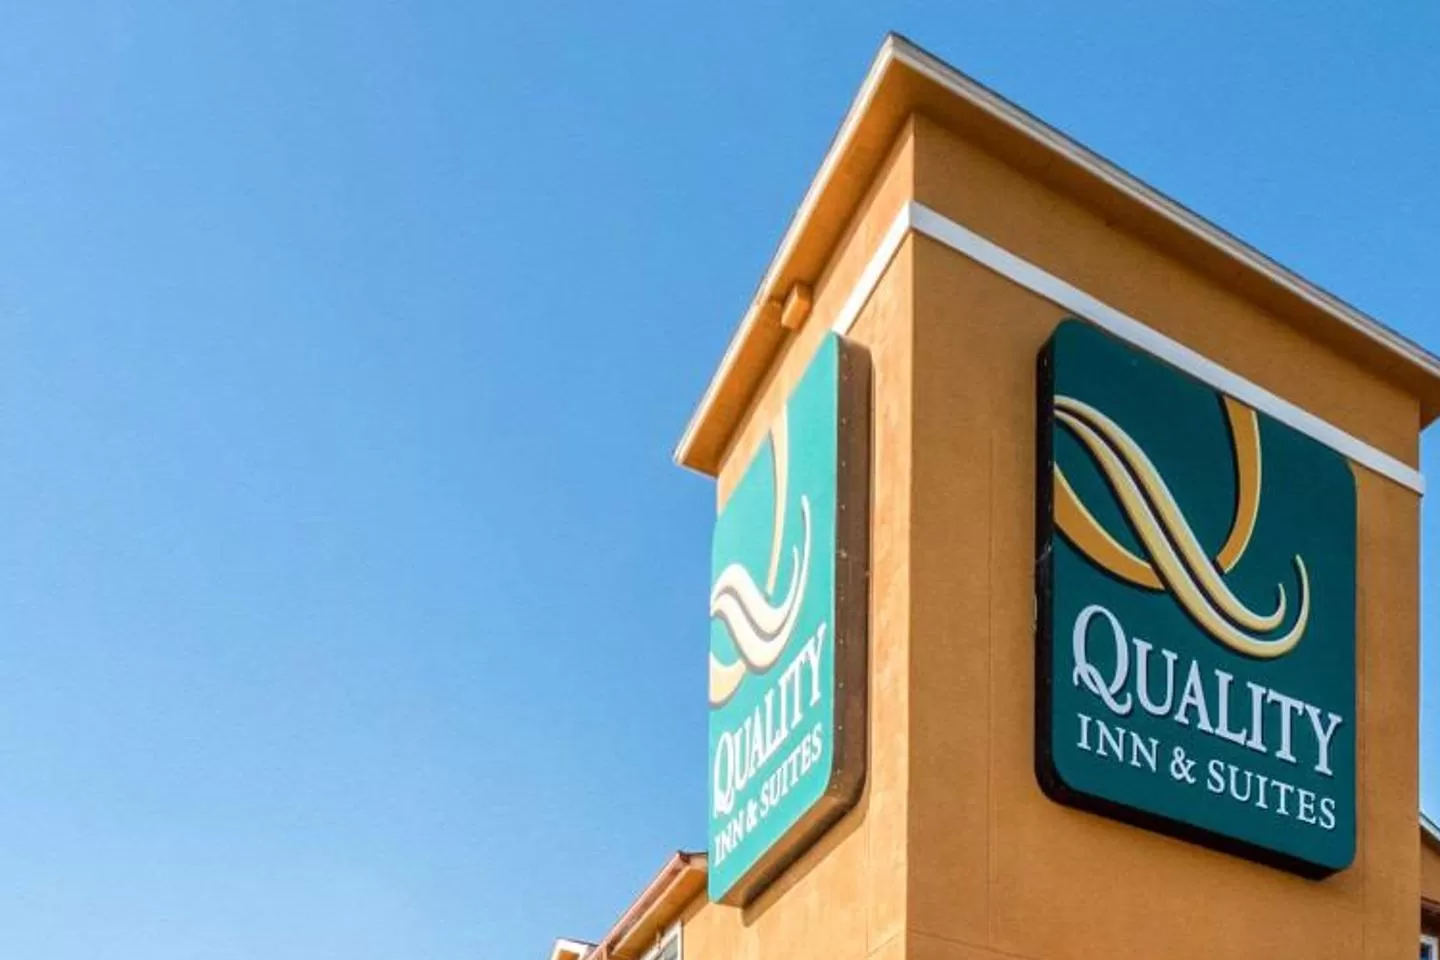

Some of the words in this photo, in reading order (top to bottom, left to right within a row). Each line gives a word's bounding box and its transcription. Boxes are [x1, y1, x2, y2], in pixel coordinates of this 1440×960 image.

[713, 621, 827, 818] QUALITY
[1072, 604, 1343, 776] QUALITY
[714, 809, 744, 867] INN
[746, 798, 758, 832] &
[760, 722, 823, 818] SUITES
[1077, 713, 1159, 773] INN
[1170, 746, 1197, 784] &
[1207, 759, 1336, 830] SUITES
